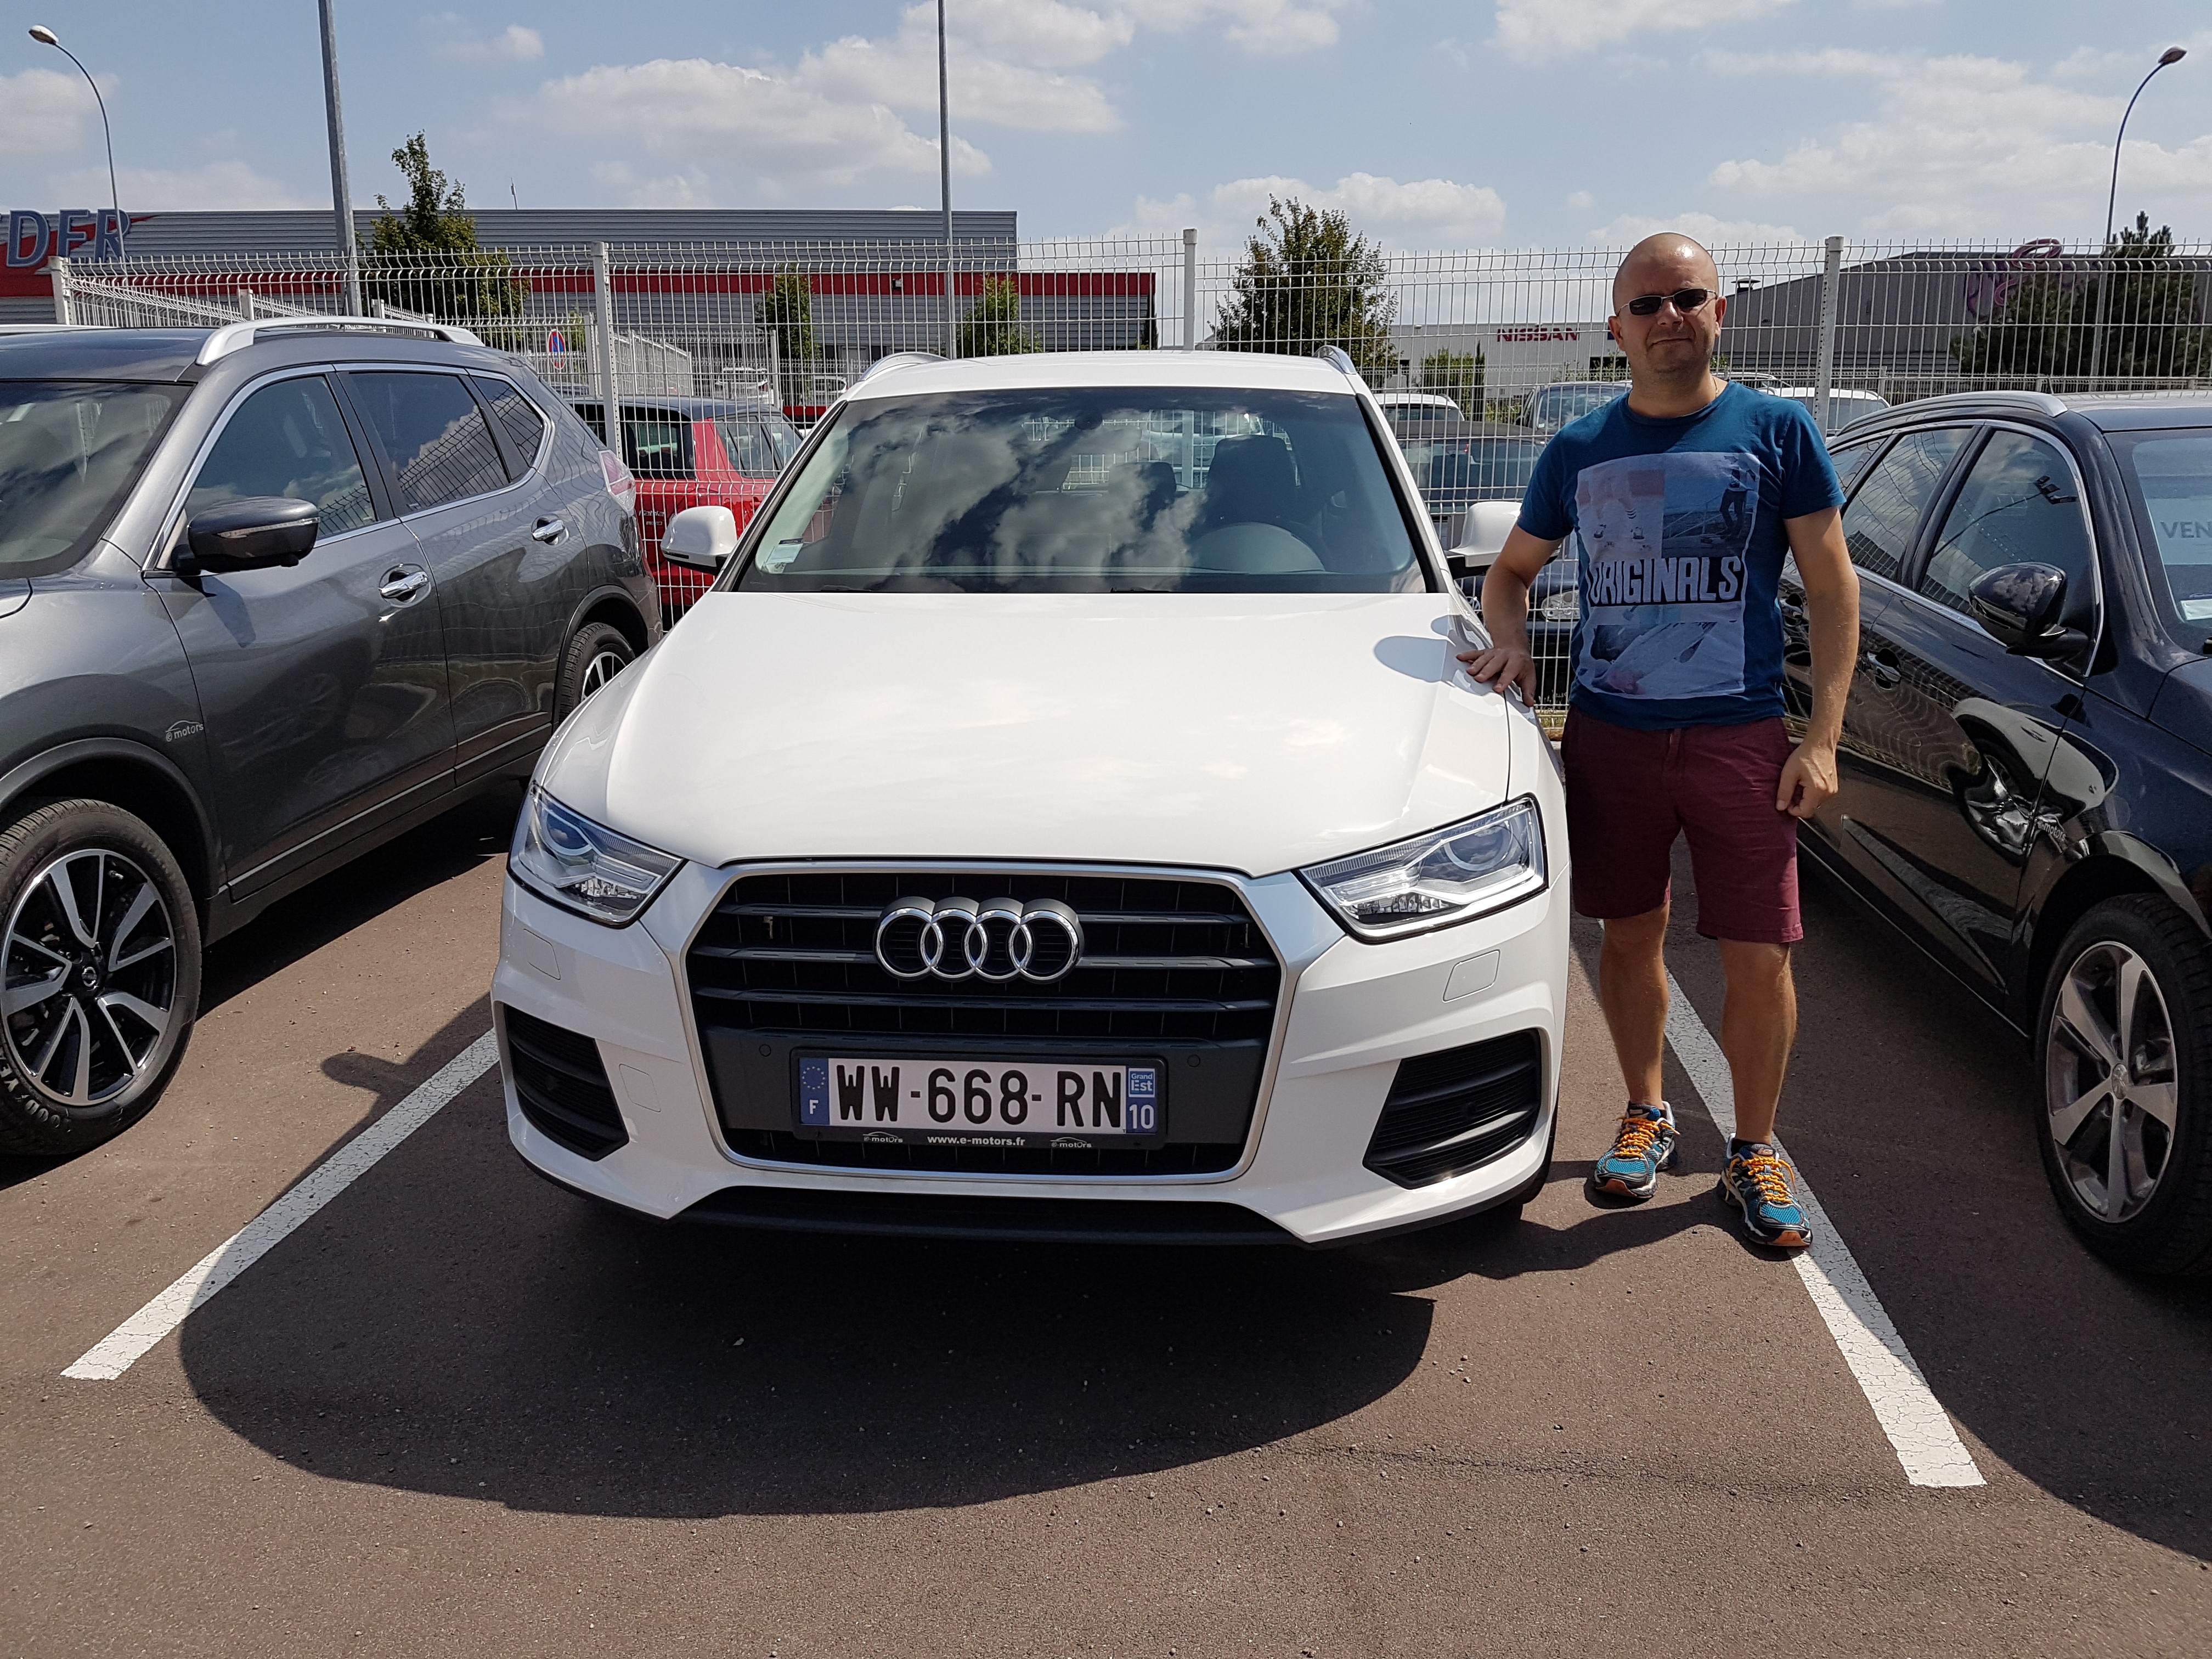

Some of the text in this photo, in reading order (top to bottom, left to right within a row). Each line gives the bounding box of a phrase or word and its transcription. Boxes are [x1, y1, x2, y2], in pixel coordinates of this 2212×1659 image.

[0, 209, 131, 266] DER
[1497, 328, 1581, 342] NISSAN
[2160, 521, 2212, 539] VEN
[1590, 556, 1741, 604] ORIGINALS
[1131, 1080, 1153, 1092] Est
[809, 1099, 819, 1114] F
[1129, 1104, 1154, 1129] 10
[927, 1136, 1026, 1146] www.e-motors.fr
